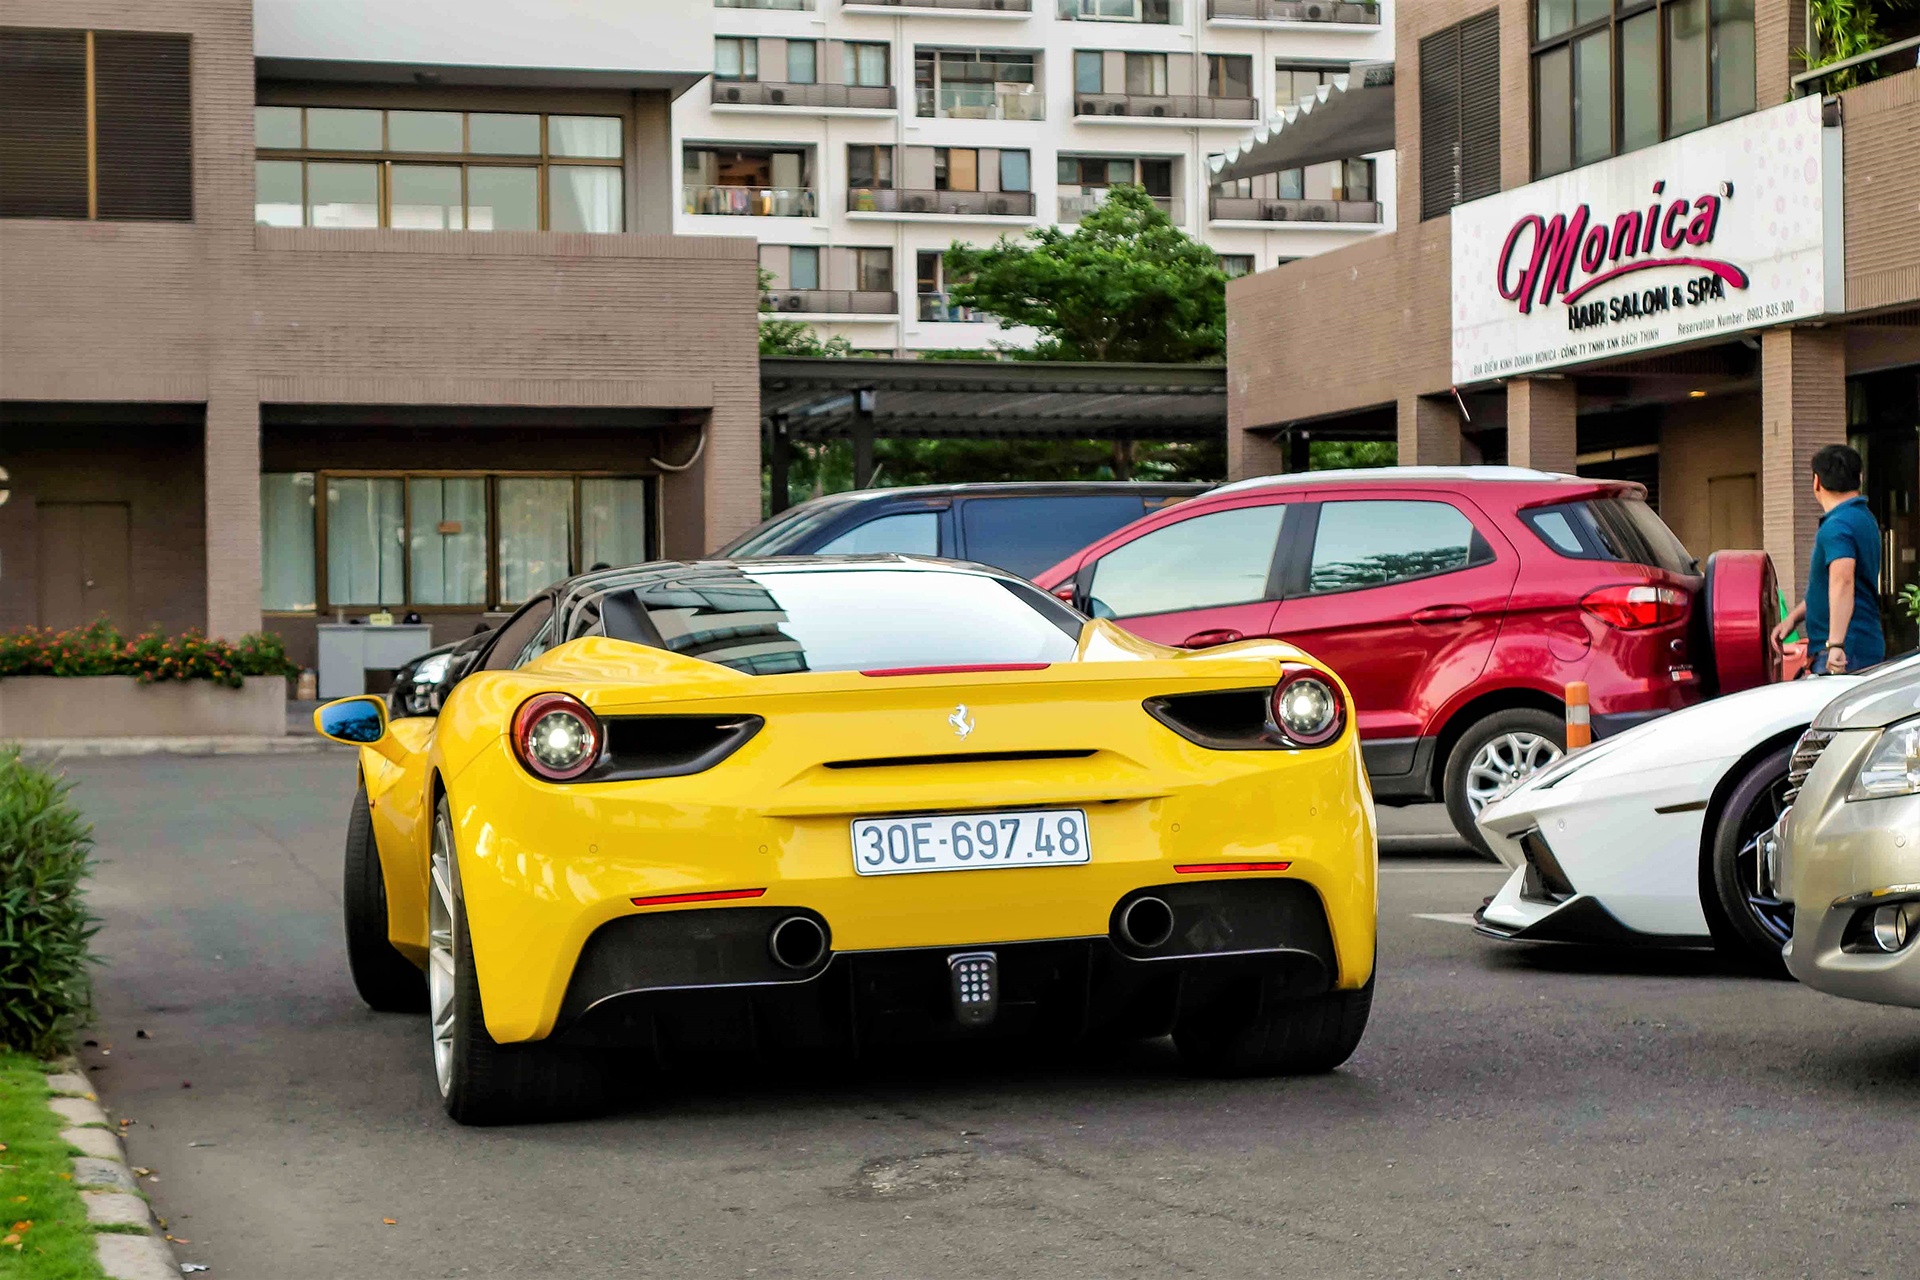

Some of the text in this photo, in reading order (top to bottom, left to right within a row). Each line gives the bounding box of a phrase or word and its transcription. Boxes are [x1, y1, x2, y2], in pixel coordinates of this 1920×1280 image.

[1497, 179, 1720, 314] Monica
[1568, 273, 1725, 331] HAIR SALON & SPA
[1677, 318, 1715, 335] Reservation
[1747, 305, 1764, 321] 0903
[861, 816, 1081, 866] 30E-697.48
